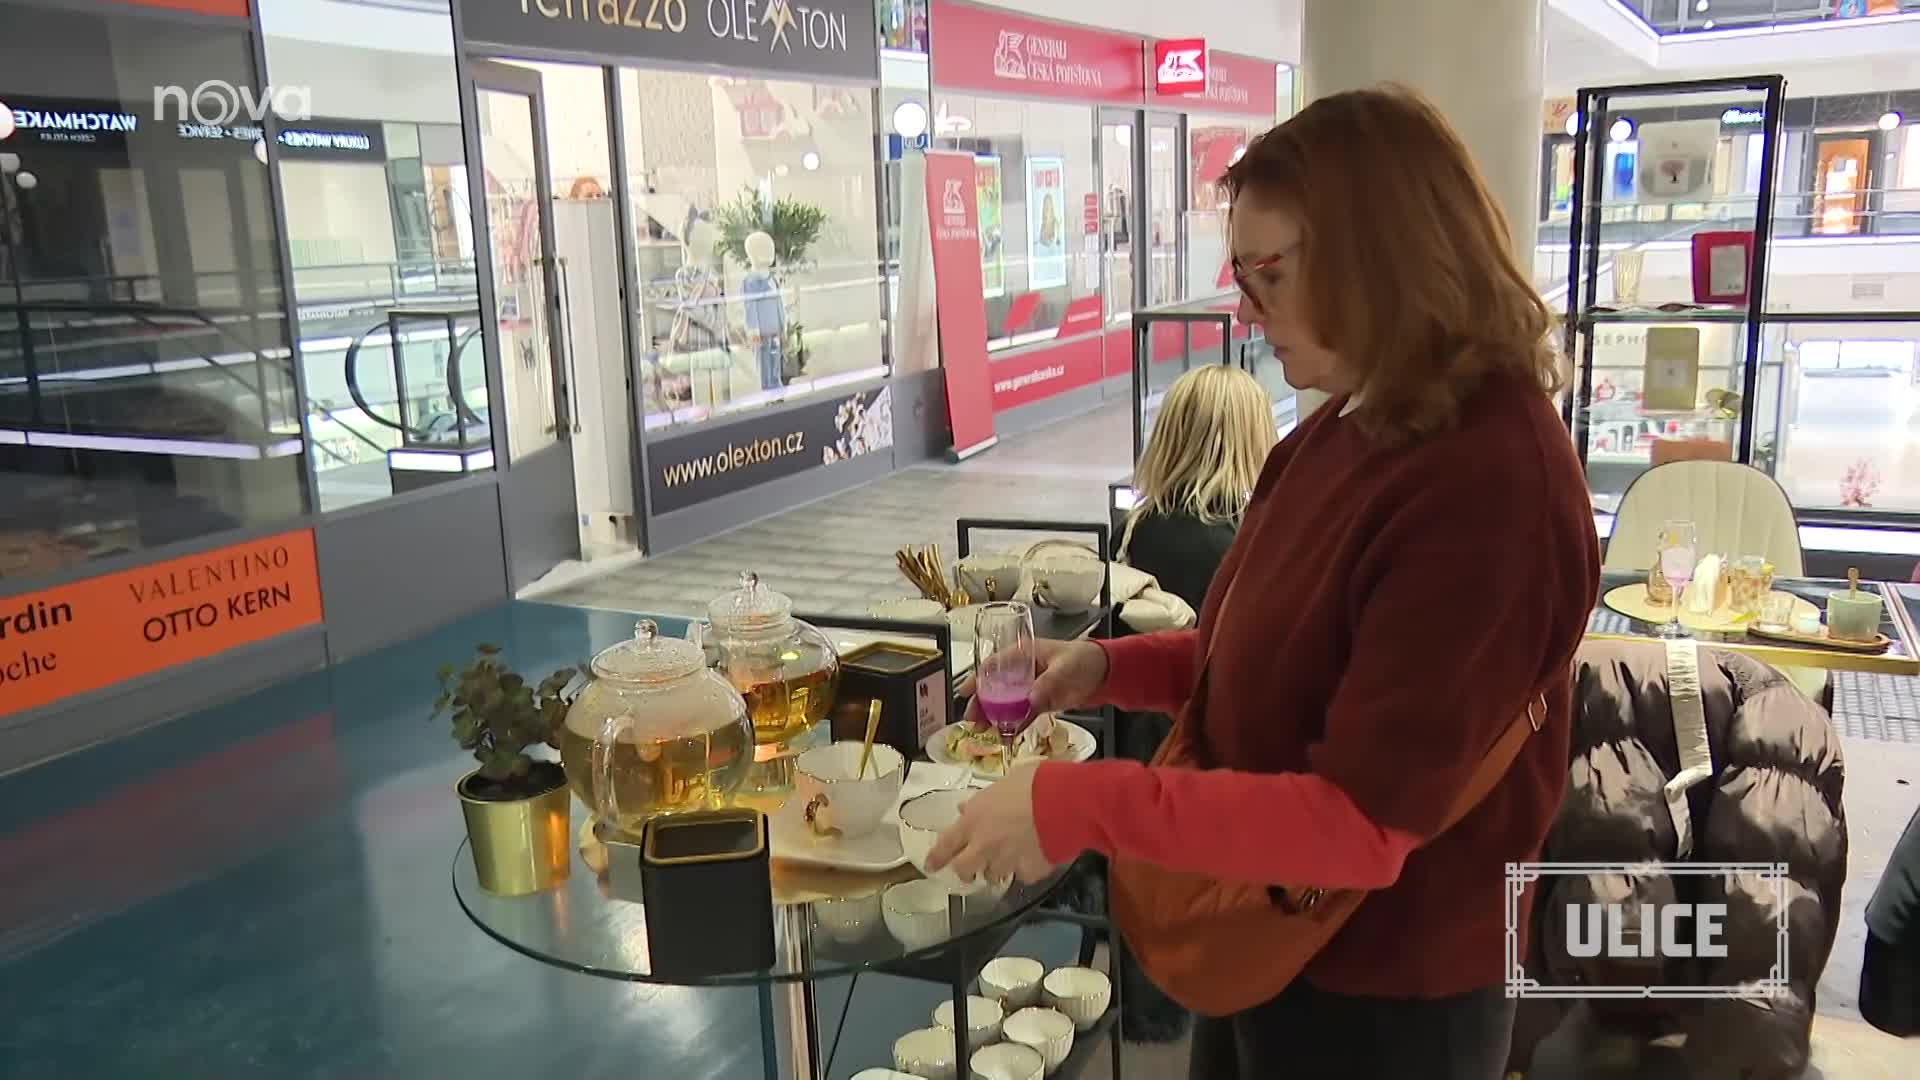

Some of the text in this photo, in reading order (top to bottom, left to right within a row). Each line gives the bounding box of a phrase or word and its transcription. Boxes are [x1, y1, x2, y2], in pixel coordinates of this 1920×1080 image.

[1026, 36, 1067, 60] GENERALI
[663, 431, 804, 488] www.olexton.cz
[129, 546, 288, 603] VALENTINO
[143, 582, 291, 642] OTTO KERN
